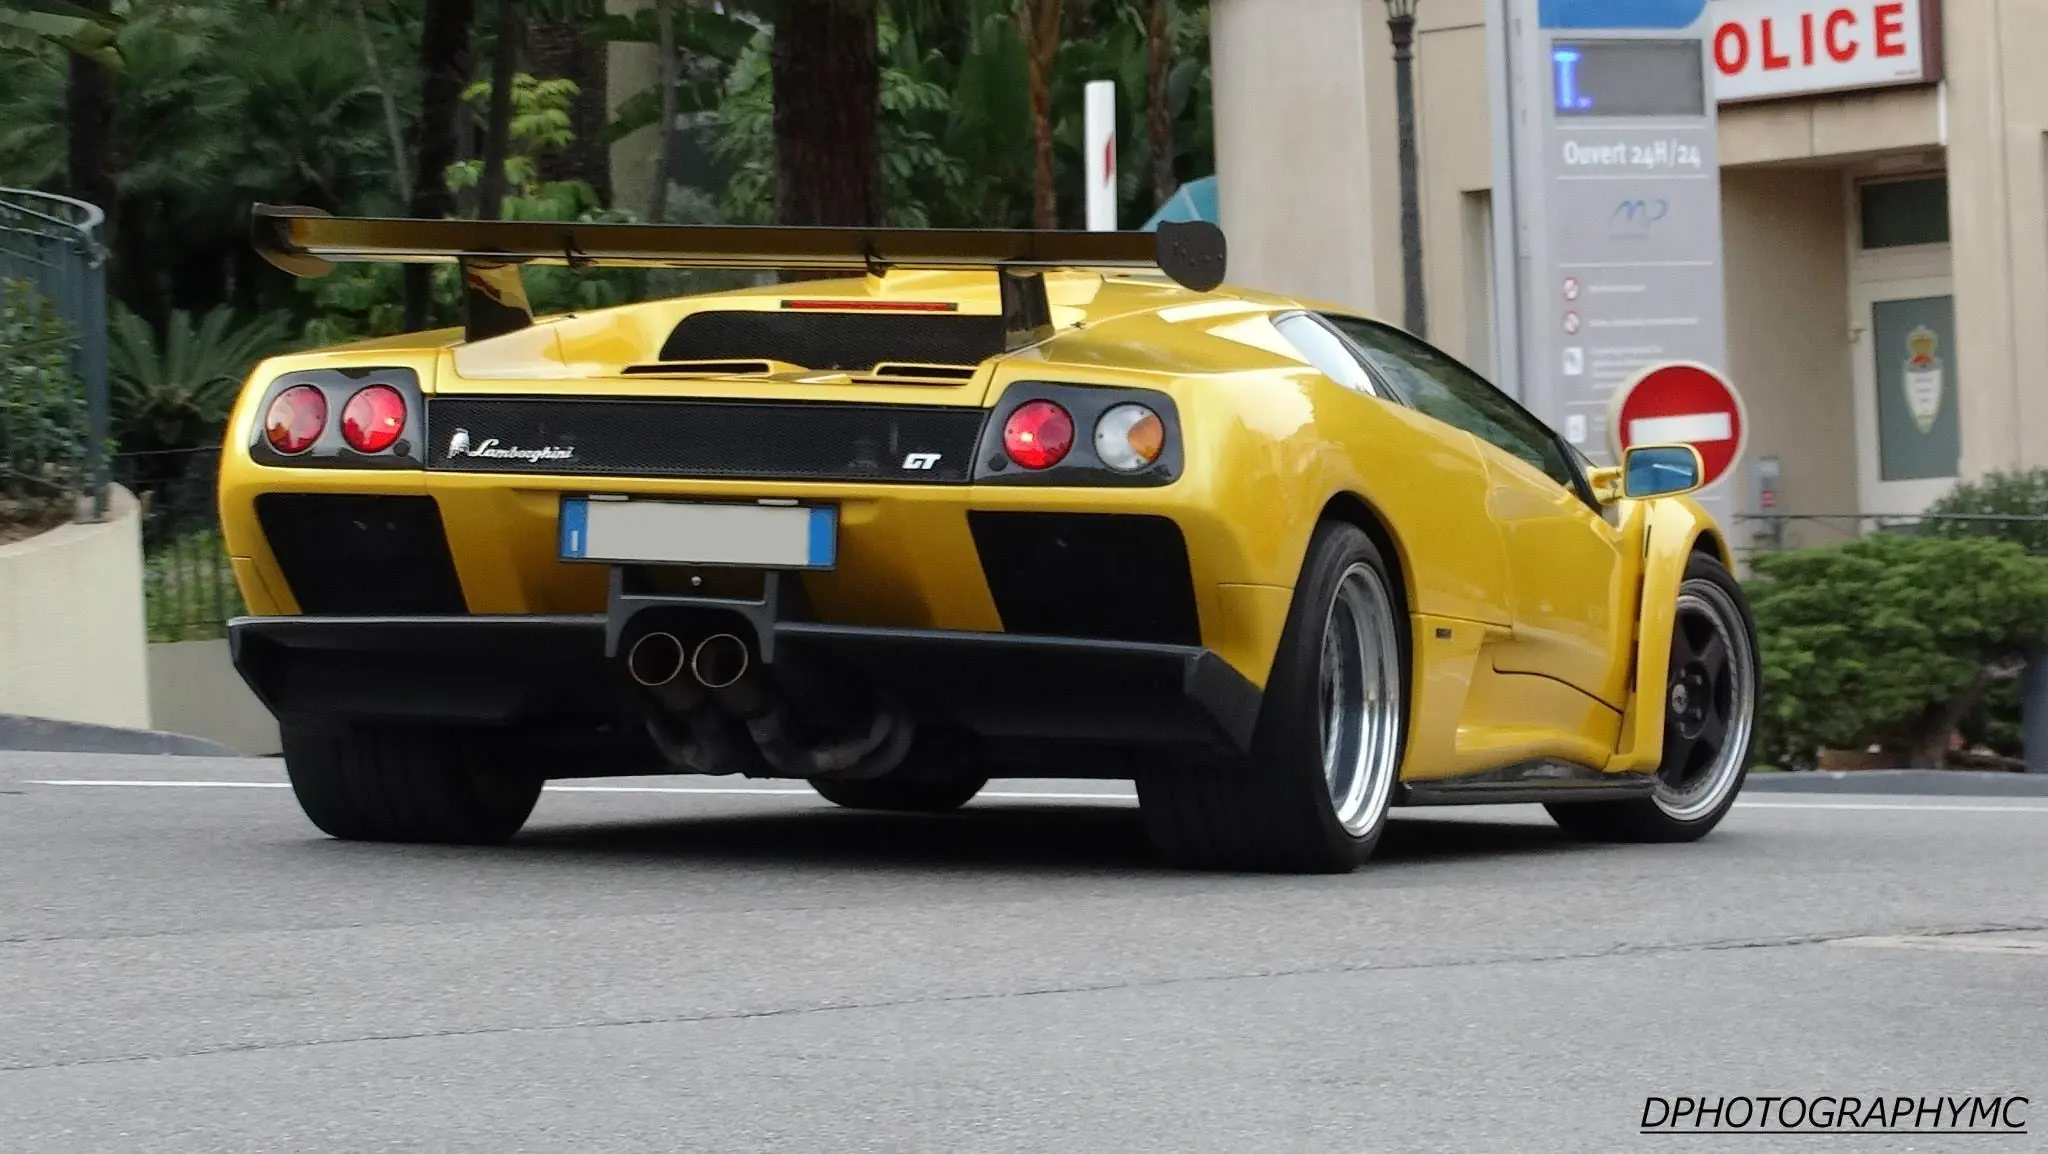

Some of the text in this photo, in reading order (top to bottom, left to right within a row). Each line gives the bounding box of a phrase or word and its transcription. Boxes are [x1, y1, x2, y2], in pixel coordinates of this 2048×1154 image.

[1563, 140, 1701, 169] Ouvert 24H/24
[470, 438, 575, 463] Lamborghini
[902, 452, 942, 470] GT
